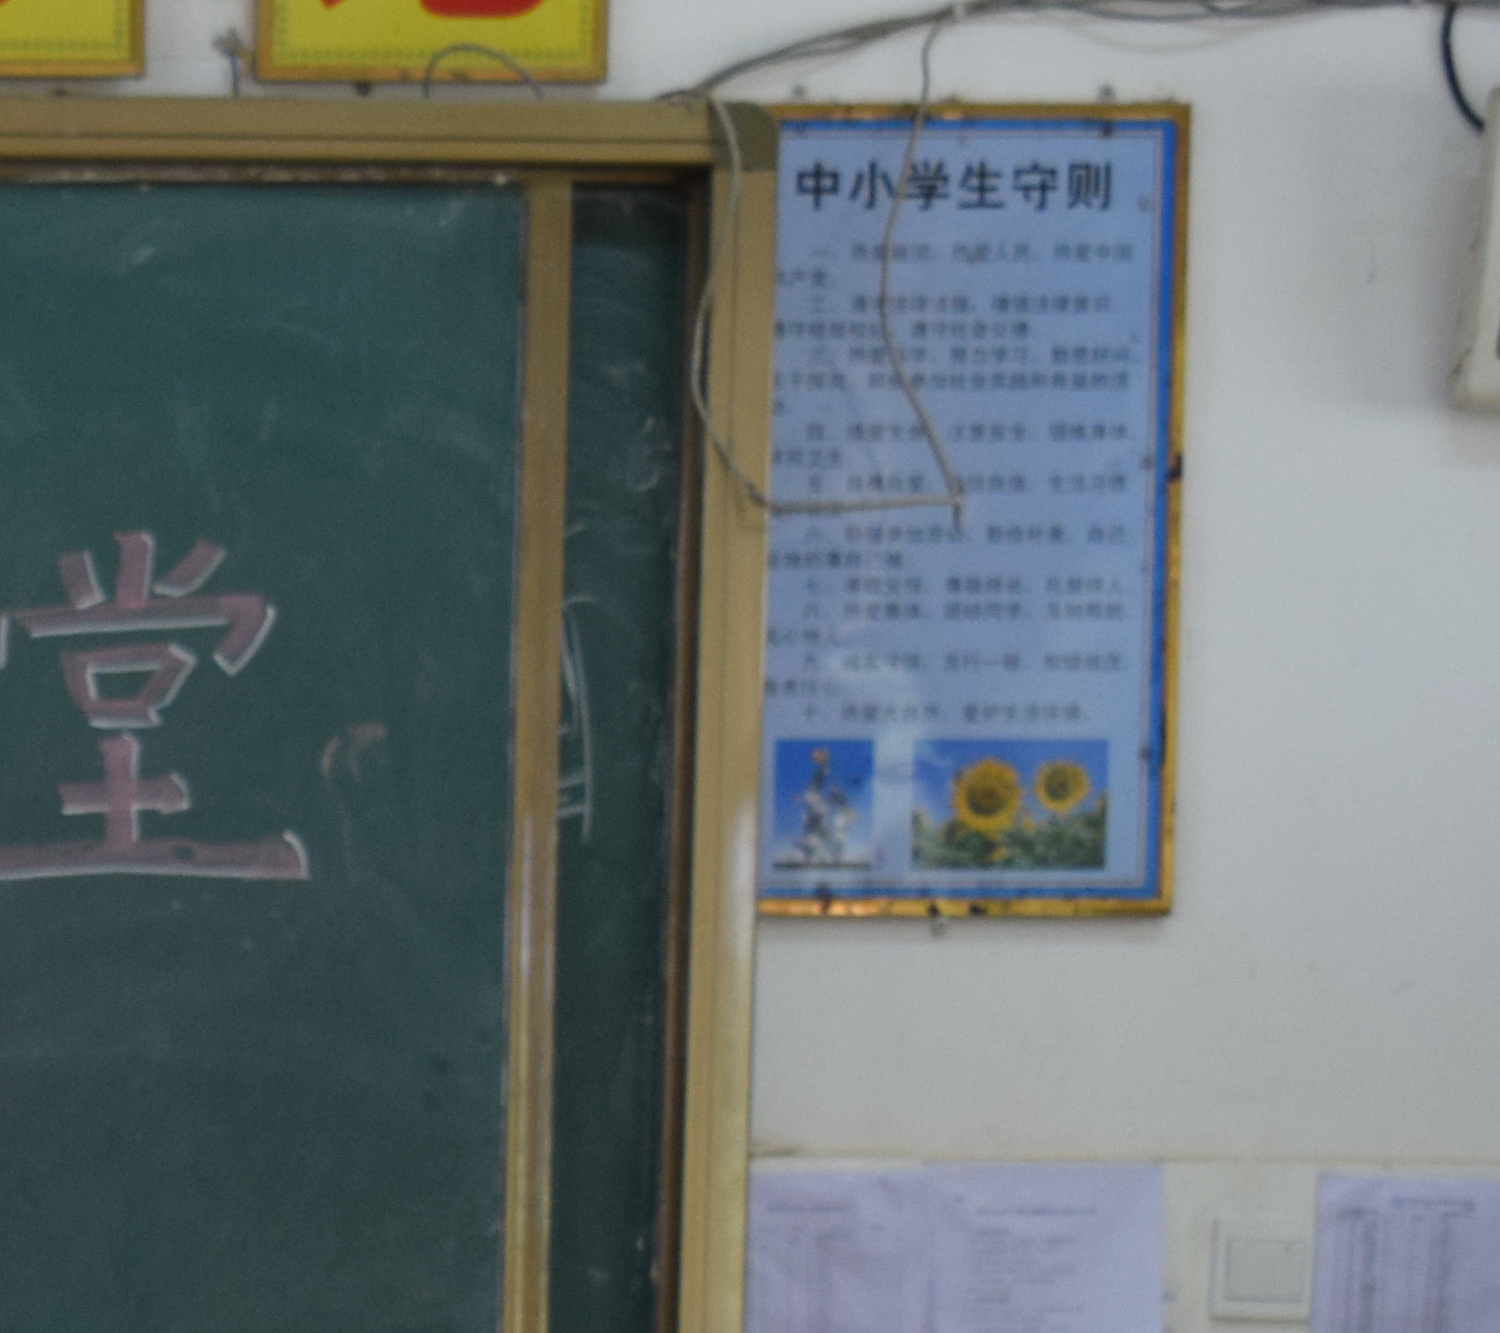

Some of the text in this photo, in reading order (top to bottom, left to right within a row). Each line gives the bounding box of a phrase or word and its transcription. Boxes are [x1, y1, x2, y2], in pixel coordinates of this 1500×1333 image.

[795, 159, 1112, 212] 中小学生守则
